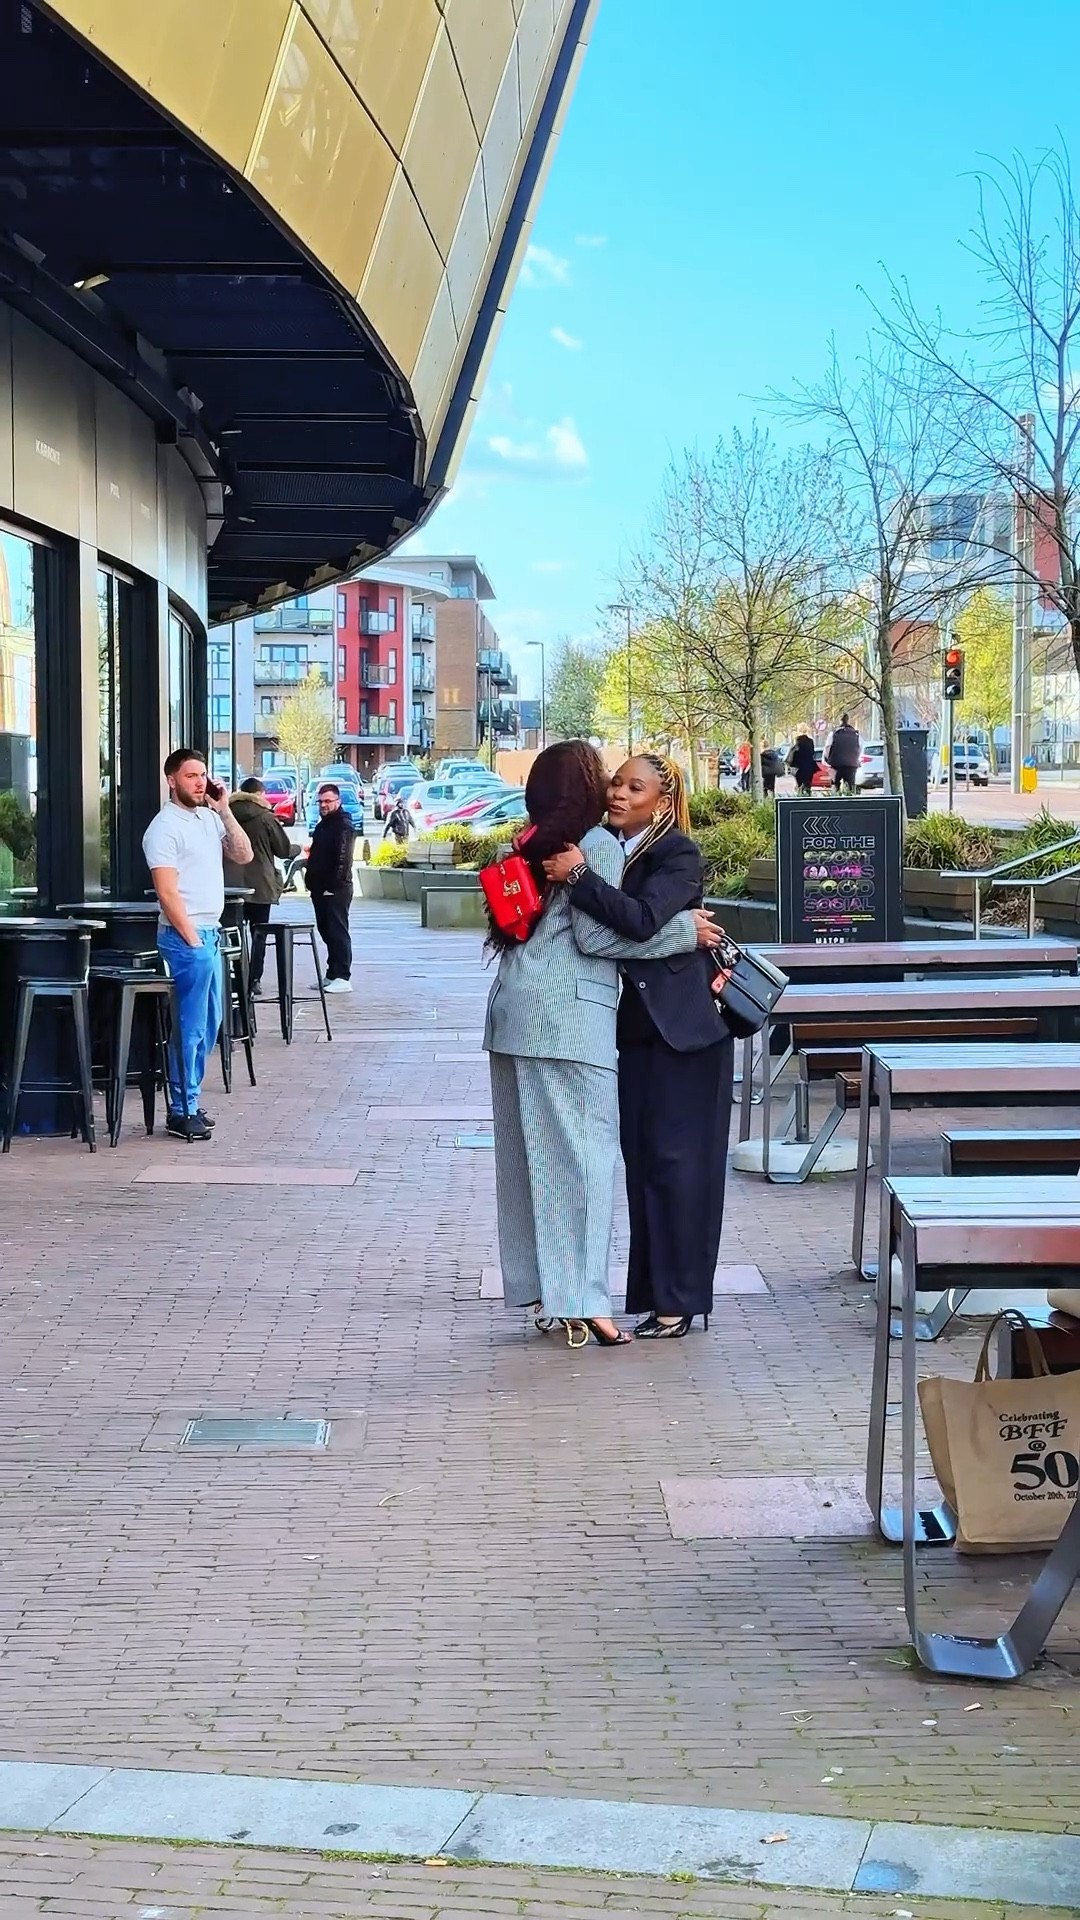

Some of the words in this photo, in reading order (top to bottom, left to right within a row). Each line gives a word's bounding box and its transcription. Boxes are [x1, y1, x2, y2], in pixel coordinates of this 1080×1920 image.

[803, 836, 836, 849] FOR
[840, 836, 875, 848] THE
[803, 850, 875, 865] SPORT
[803, 865, 875, 879] GAMES
[803, 879, 875, 898] FOOD
[804, 897, 875, 912] SOCIAL
[999, 1410, 1060, 1422] Celebrating
[999, 1418, 1068, 1441] BFF
[1028, 1440, 1047, 1452] @
[1010, 1450, 1079, 1490] 50
[1014, 1492, 1046, 1502] October
